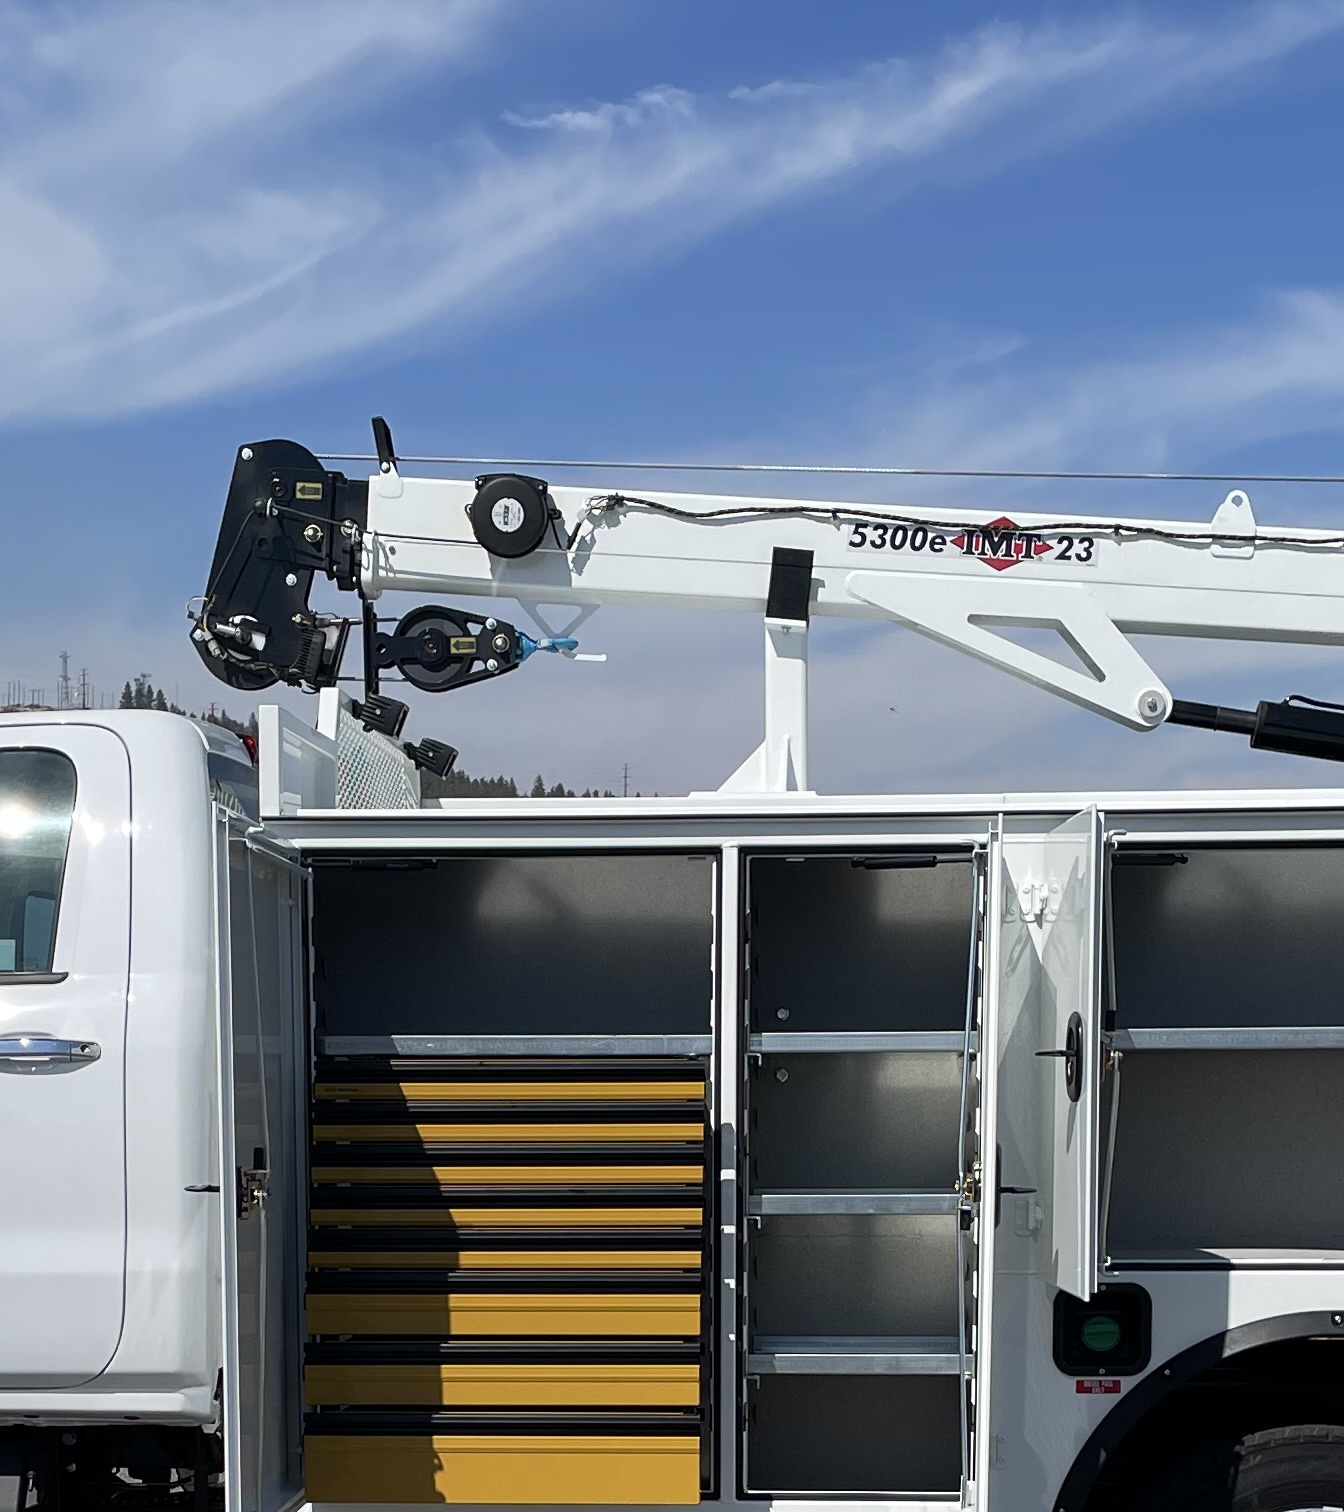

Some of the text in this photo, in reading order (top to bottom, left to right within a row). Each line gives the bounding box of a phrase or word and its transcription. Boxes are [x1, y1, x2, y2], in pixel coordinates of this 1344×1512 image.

[848, 523, 1094, 562] 5300e IMT 23
